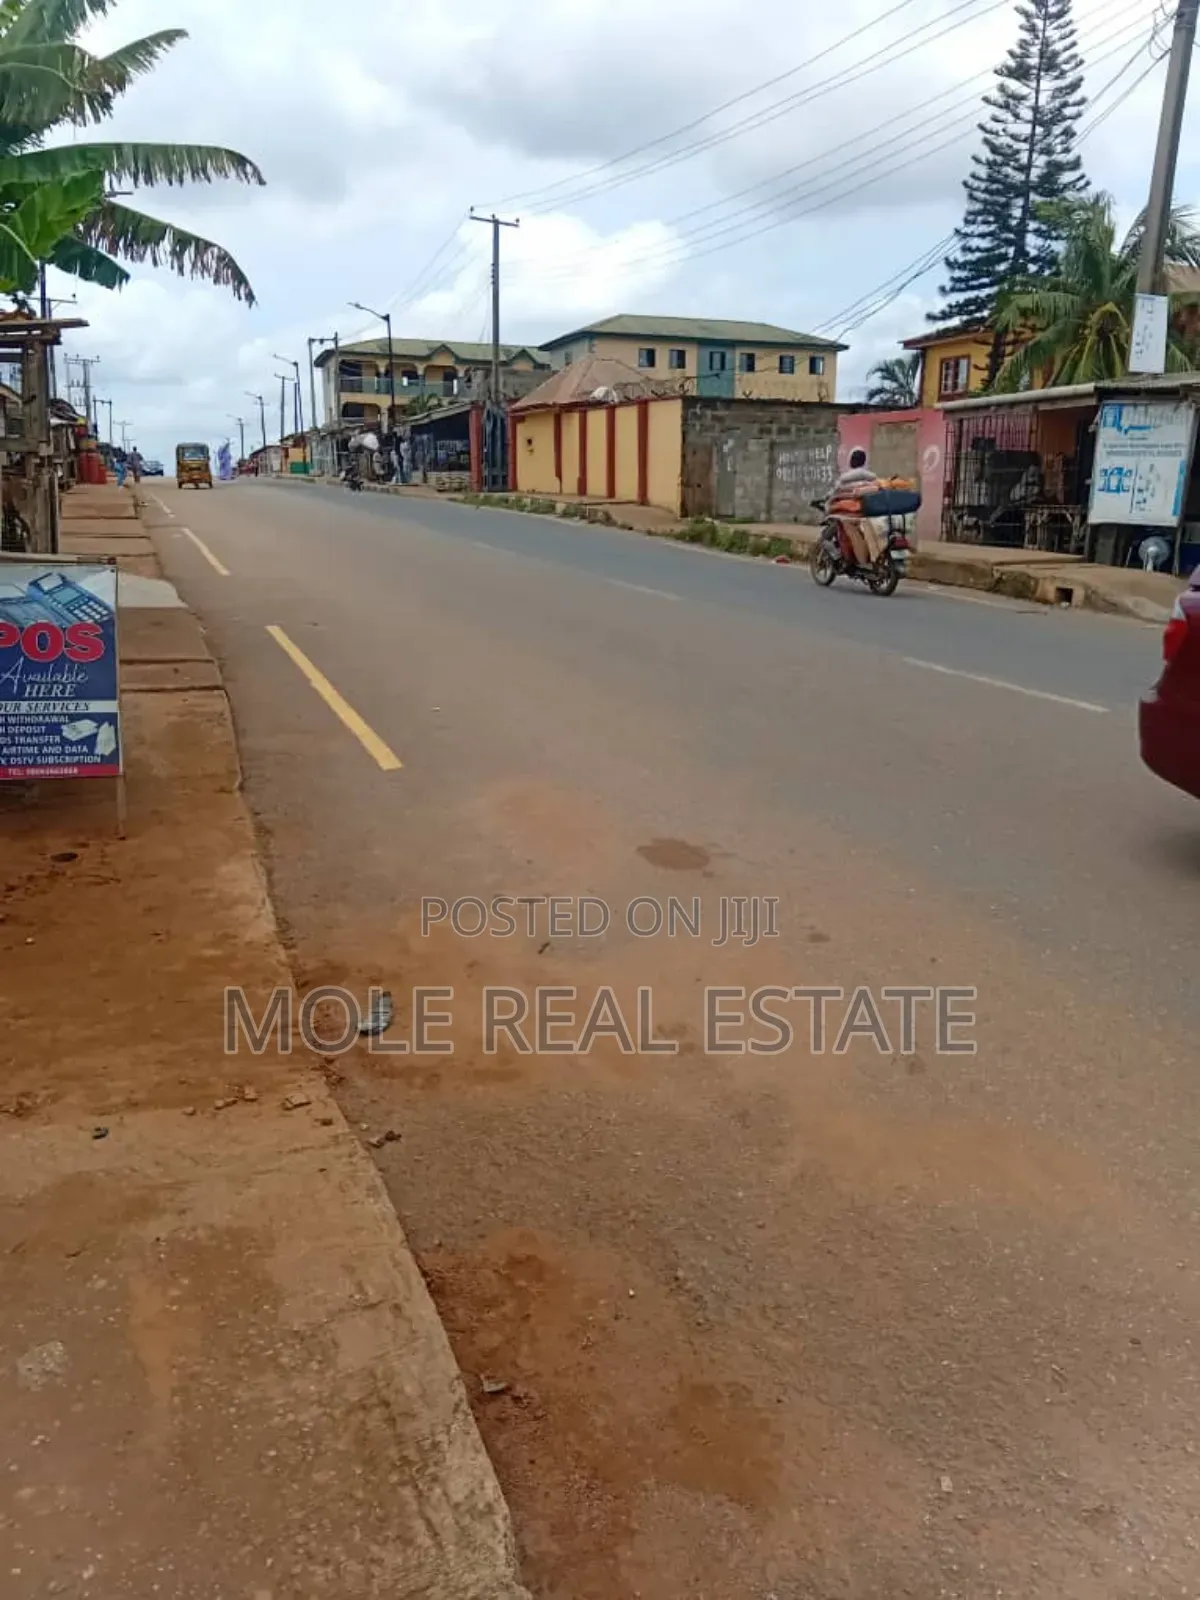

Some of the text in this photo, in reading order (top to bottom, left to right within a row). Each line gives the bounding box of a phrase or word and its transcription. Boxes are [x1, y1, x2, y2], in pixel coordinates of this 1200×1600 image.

[23, 683, 76, 697] HERE
[25, 702, 89, 713] SERVICES
[7, 715, 69, 723] WITHDRAWAL
[8, 725, 46, 734] DEPOSIT
[15, 735, 60, 744] TRANSFER
[42, 745, 62, 754] AND
[64, 744, 88, 754] DATA
[11, 756, 34, 765] DSTV
[36, 755, 101, 764] SUBSCRIPTION
